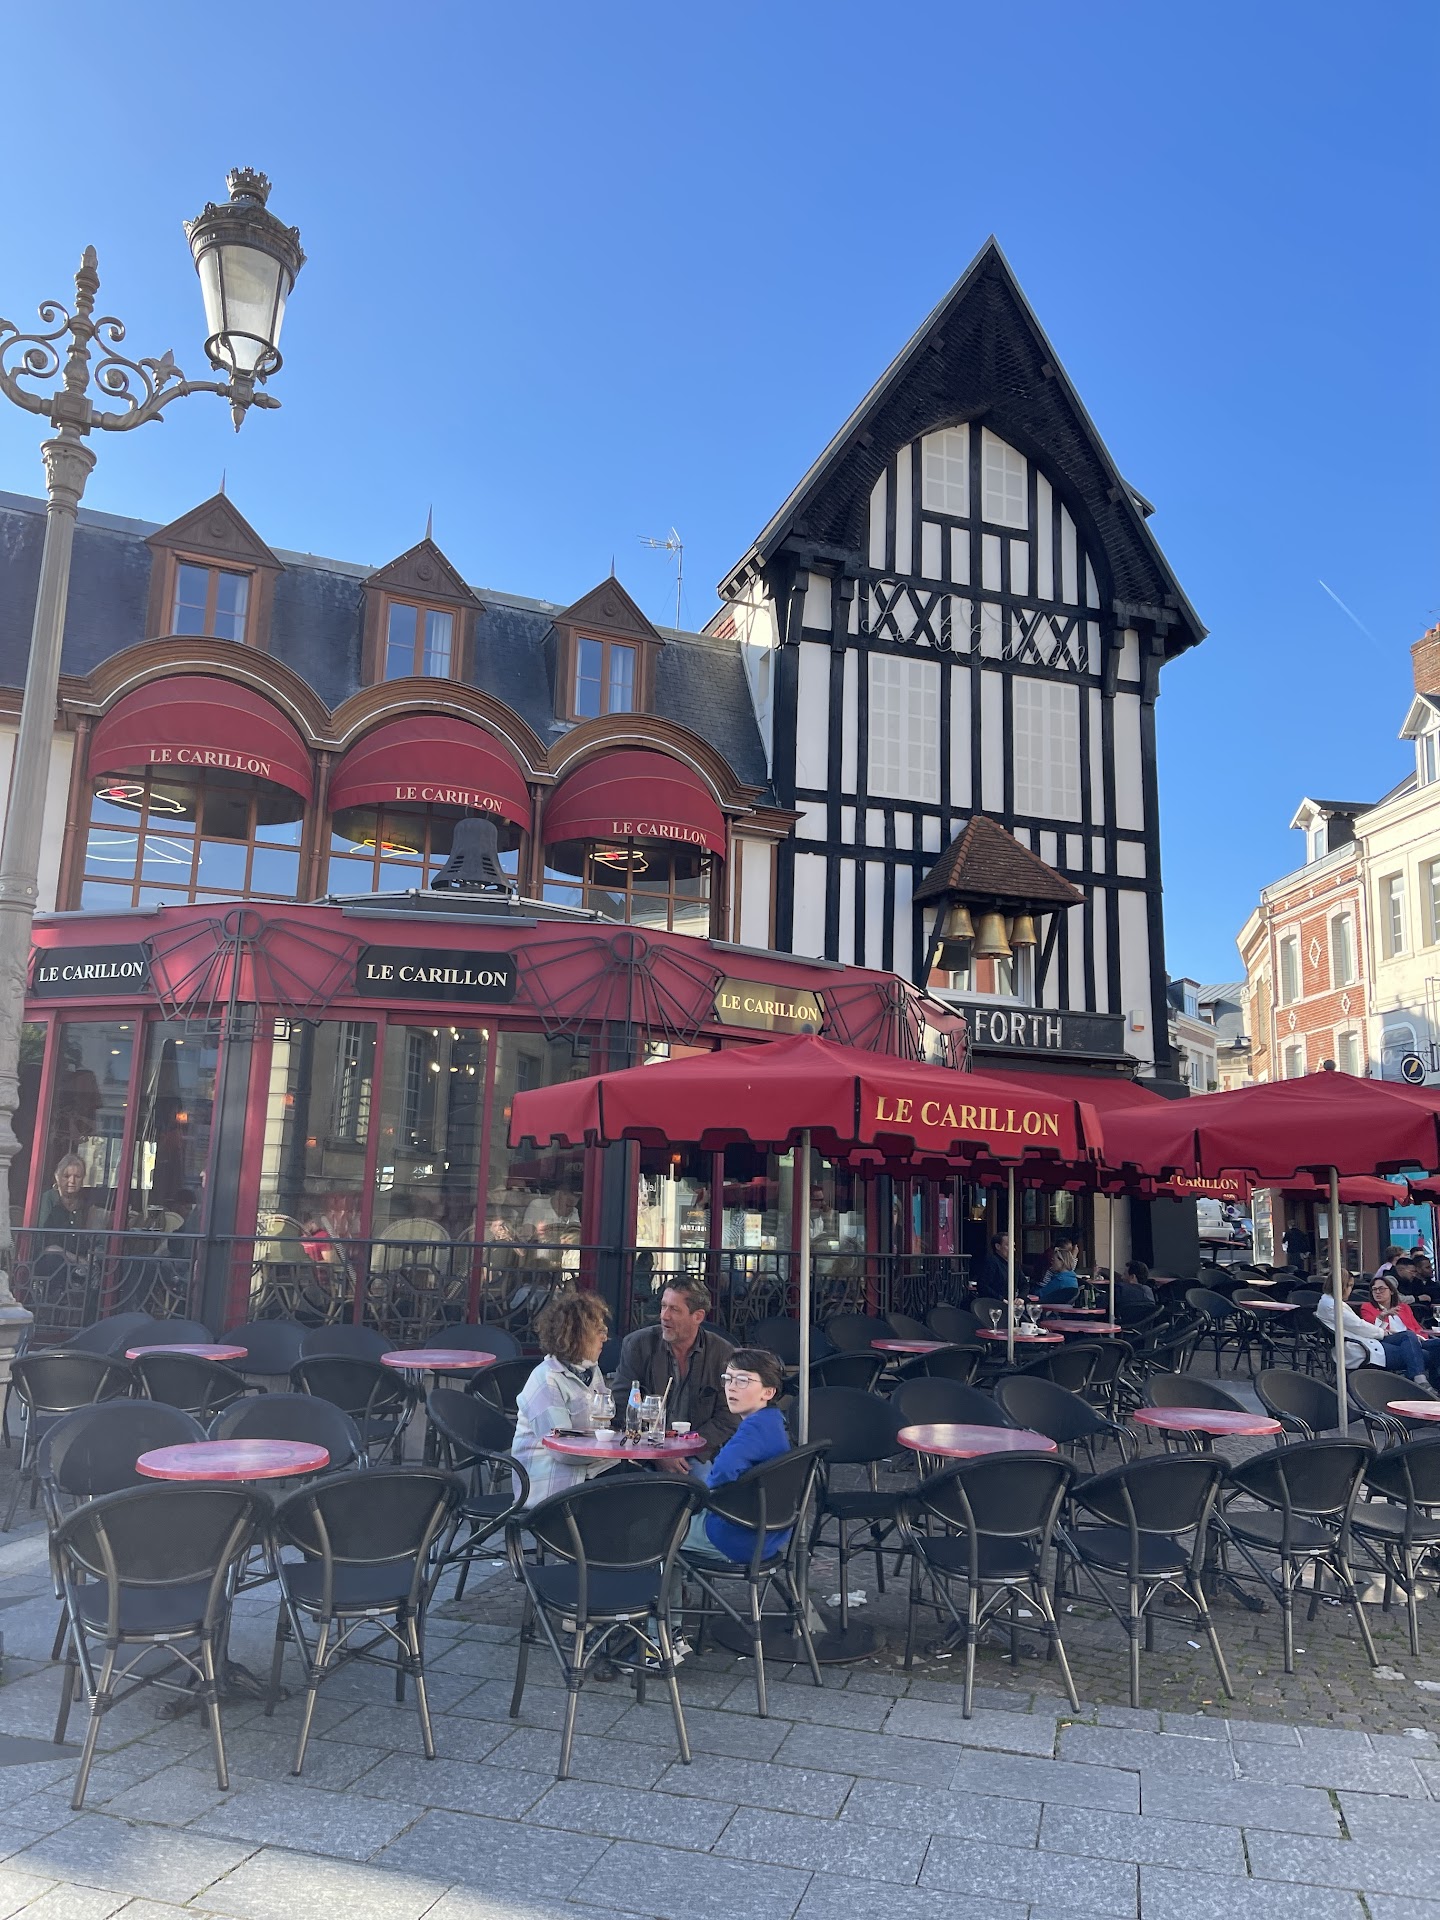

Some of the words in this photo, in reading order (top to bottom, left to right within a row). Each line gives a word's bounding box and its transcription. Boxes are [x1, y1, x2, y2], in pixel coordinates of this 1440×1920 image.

[150, 748, 171, 762] LE
[177, 748, 271, 776] CARILLON
[395, 787, 416, 801] LE
[421, 788, 502, 813] CARILLON
[613, 821, 633, 835] LE
[637, 823, 707, 845] CARILLON
[38, 967, 59, 982] LE
[62, 962, 144, 981] CARILLON
[366, 964, 394, 980] LE
[398, 966, 508, 987] CARILLON
[721, 993, 741, 1010] LE
[744, 998, 818, 1021] CARILLON
[975, 1010, 1062, 1048] FORTH
[875, 1096, 913, 1123] LE
[920, 1102, 1059, 1137] CARILLON
